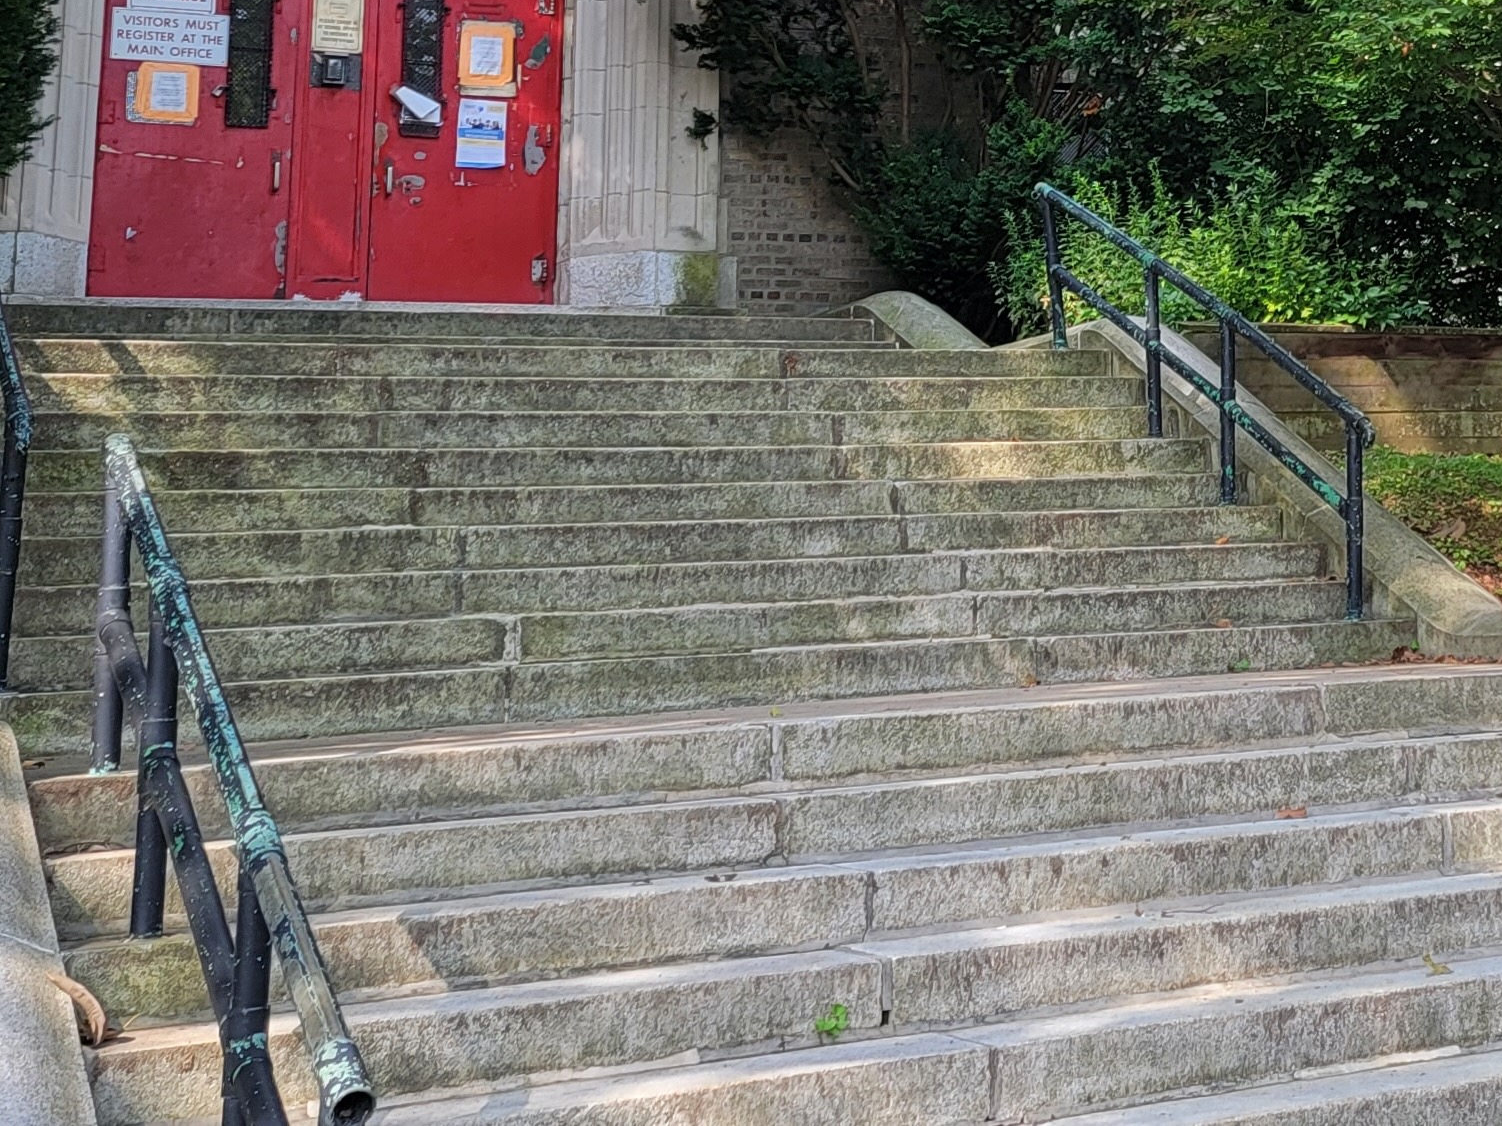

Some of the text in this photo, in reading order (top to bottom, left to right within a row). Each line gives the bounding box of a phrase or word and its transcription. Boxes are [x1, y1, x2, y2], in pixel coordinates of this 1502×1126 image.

[123, 15, 220, 31] VISITORS MUST
[116, 28, 224, 46] REGISTER AT THE
[127, 43, 213, 59] MAIN OFFICE
